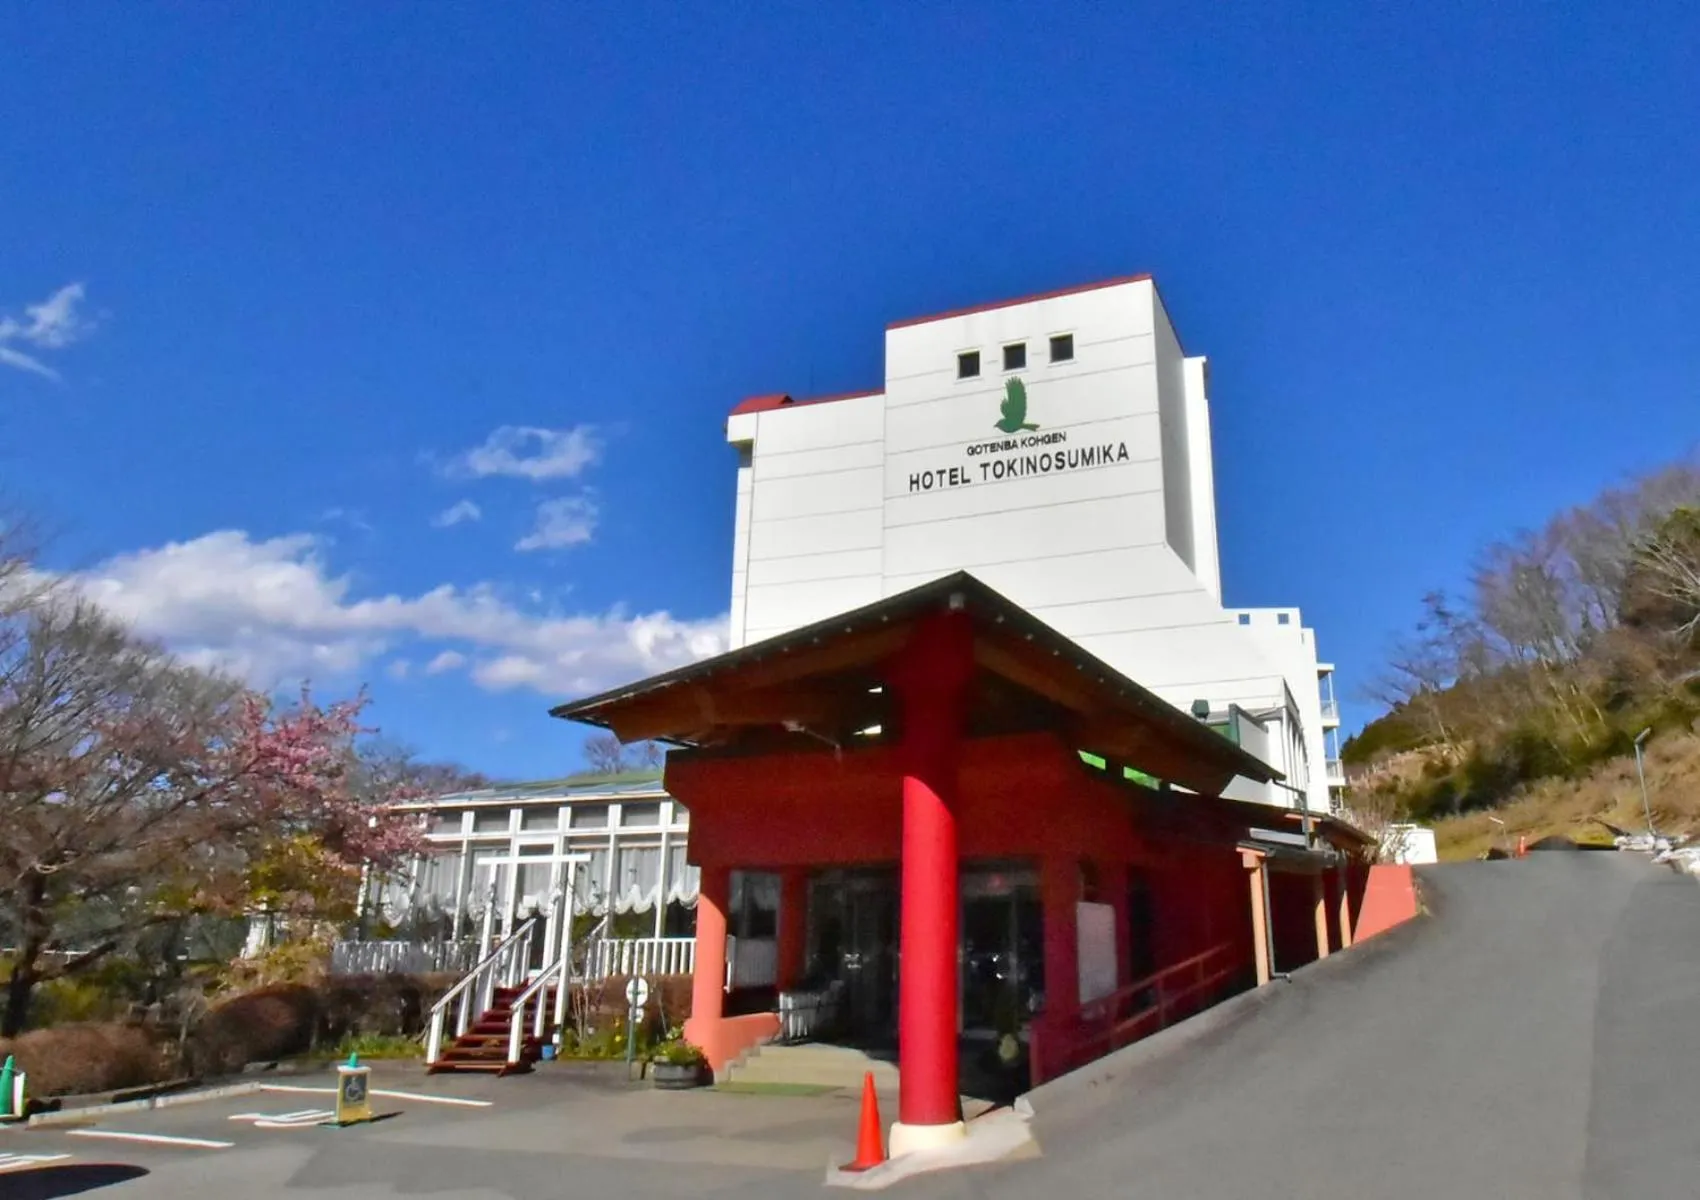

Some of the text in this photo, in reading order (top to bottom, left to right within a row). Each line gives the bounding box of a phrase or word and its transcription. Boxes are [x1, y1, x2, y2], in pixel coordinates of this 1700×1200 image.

[967, 432, 1067, 456] GOTENBA KOHGEN
[909, 442, 1129, 492] HOTEL TOKINOSUMIKA
